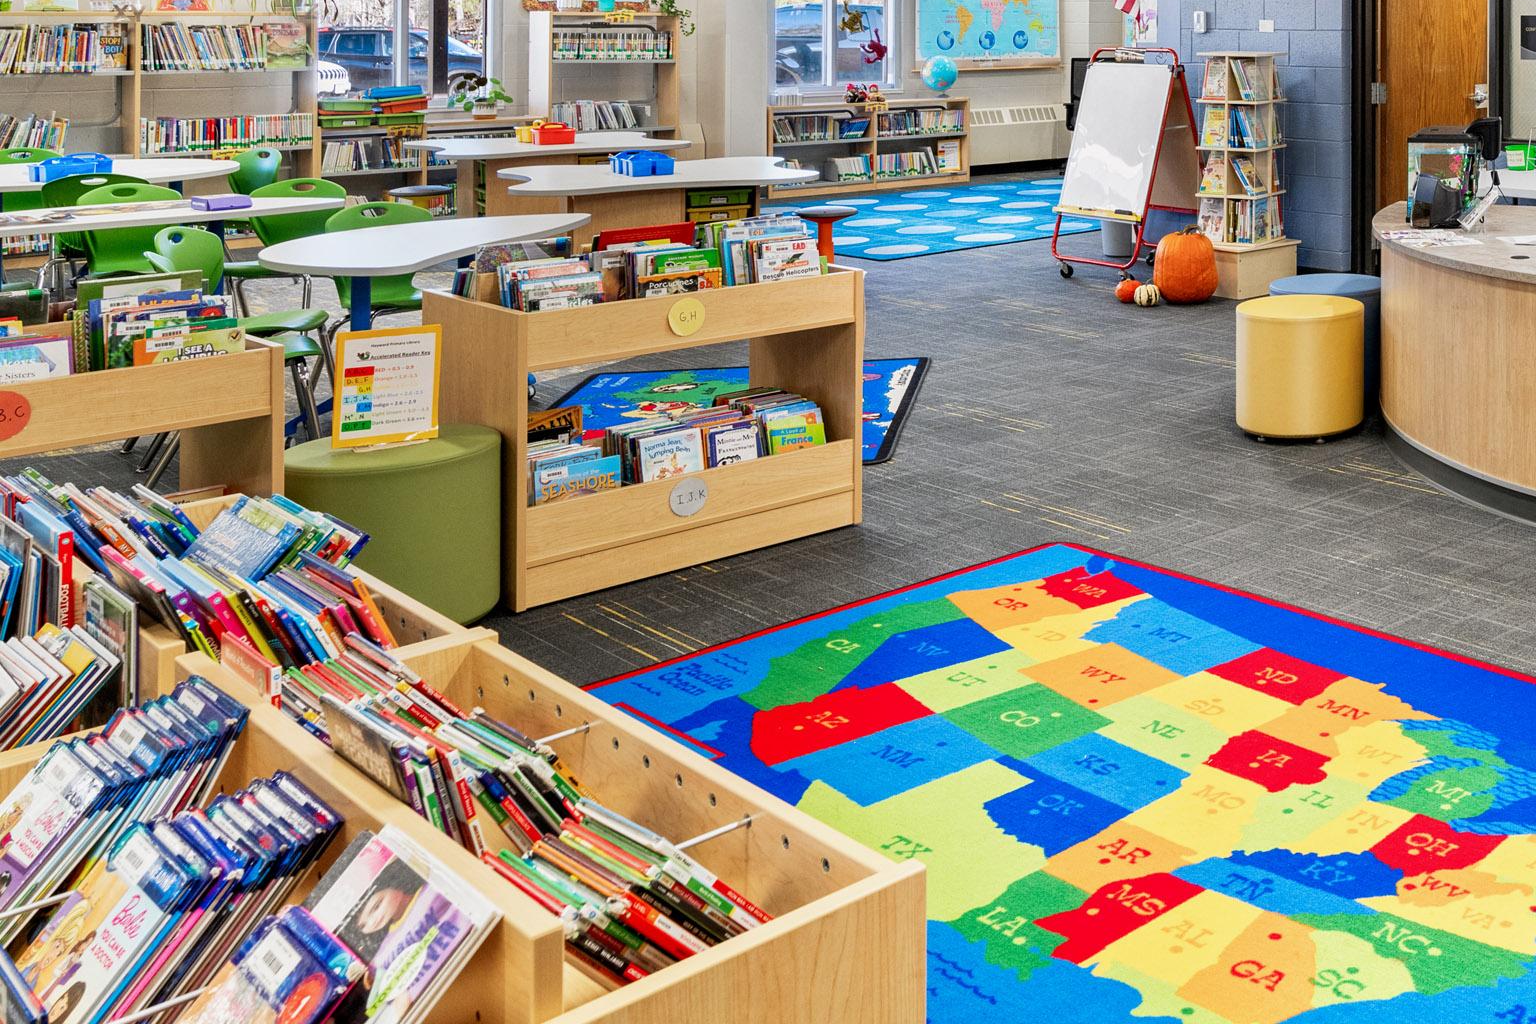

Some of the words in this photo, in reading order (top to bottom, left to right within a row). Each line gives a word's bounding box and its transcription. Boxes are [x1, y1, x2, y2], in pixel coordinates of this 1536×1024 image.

[786, 266, 820, 277] Helicopters
[184, 345, 202, 354] SEE
[205, 344, 212, 352] A
[644, 442, 666, 452] Norma
[668, 438, 682, 447] Jean,
[676, 445, 690, 453] Bean
[781, 436, 814, 446] France
[541, 472, 616, 502] SEASHORE
[1069, 581, 1110, 599] WA
[992, 596, 1031, 612] OR
[825, 638, 862, 654] CA
[1035, 628, 1068, 646] ID
[1148, 626, 1192, 644] MT
[907, 639, 952, 658] NV
[658, 672, 706, 696] Ocean
[946, 670, 988, 688] UT
[1079, 666, 1127, 686] WY
[1255, 666, 1298, 686] ND
[1000, 710, 1042, 728] CO
[1183, 698, 1226, 718] SD
[1316, 698, 1371, 721] MN
[812, 710, 850, 730] AZ
[1140, 719, 1186, 740] NE
[870, 744, 926, 770] NM
[1074, 754, 1122, 776] KS
[1255, 748, 1294, 769] IA
[1356, 744, 1404, 766] WI
[1192, 784, 1248, 810] MO
[1298, 790, 1336, 810] IL
[1424, 778, 1472, 804] MI
[1036, 794, 1086, 817] OK
[1345, 809, 1392, 832] IN
[880, 834, 934, 859] TX
[1096, 838, 1152, 866] AR
[1404, 832, 1460, 858] OH
[1300, 859, 1358, 888] KY
[1220, 872, 1276, 902] TN
[1420, 874, 1472, 901] WV
[1106, 884, 1168, 916] MS
[112, 894, 148, 939] Barbie
[976, 906, 1028, 938] LA
[1458, 906, 1496, 930] VA
[1160, 920, 1215, 950] AL
[1372, 920, 1434, 956] NC
[1230, 959, 1286, 992] GA
[1309, 968, 1366, 1002] SC
